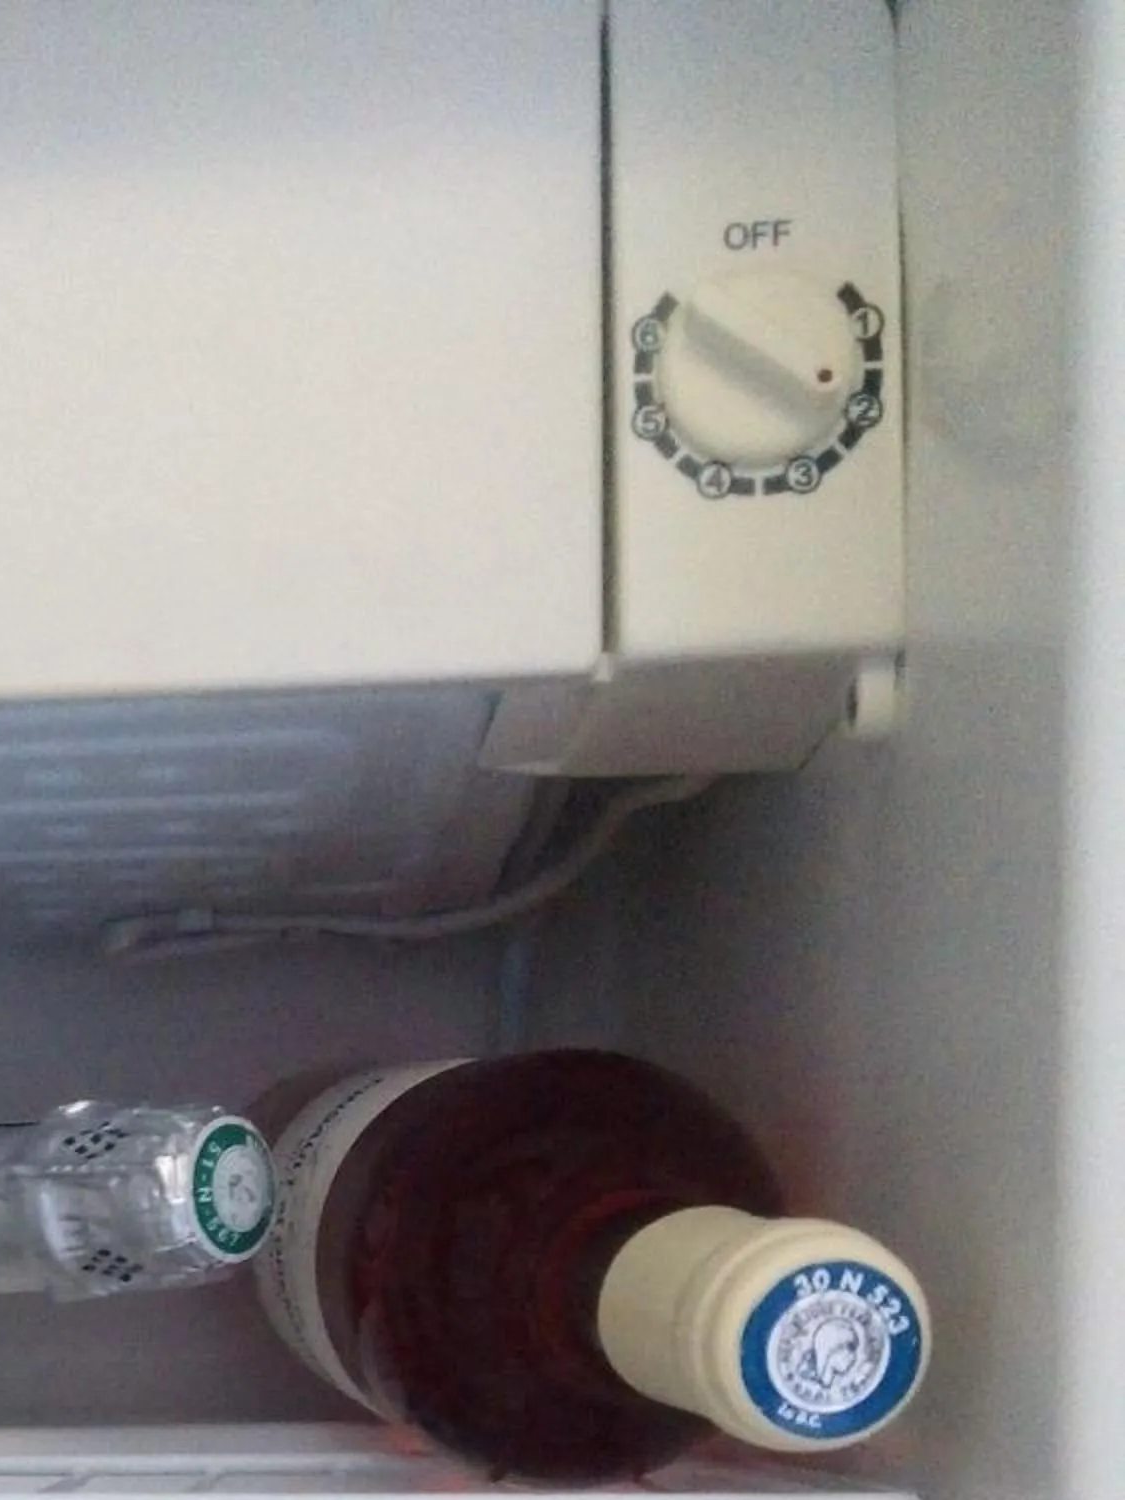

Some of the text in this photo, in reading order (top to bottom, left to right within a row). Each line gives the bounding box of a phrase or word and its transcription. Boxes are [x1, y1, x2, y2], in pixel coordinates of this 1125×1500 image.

[724, 220, 793, 250] OFF
[794, 1268, 910, 1335] 30 N 523
